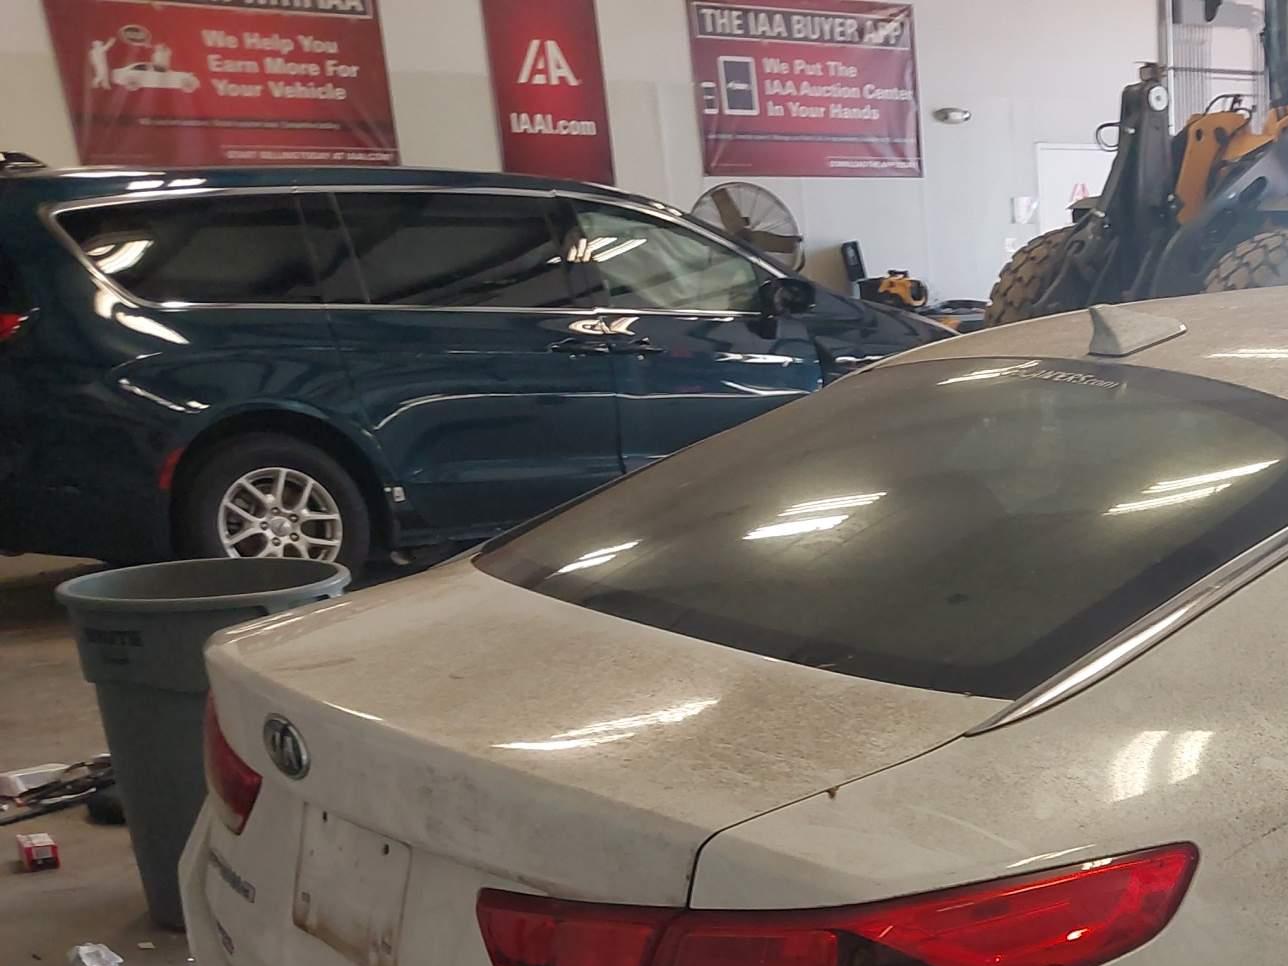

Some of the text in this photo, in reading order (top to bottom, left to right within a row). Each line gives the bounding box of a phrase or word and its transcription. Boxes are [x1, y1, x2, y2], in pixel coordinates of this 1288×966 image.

[701, 8, 744, 35] THE
[748, 12, 788, 38] IAA
[790, 15, 859, 42] BUYER
[202, 29, 338, 54] We Help You
[207, 54, 360, 77] Earn More For
[762, 58, 858, 78] We Put The
[211, 79, 347, 100] Your Vehicle
[764, 79, 914, 101] IAA Auction Center
[767, 101, 880, 120] In Your Hands
